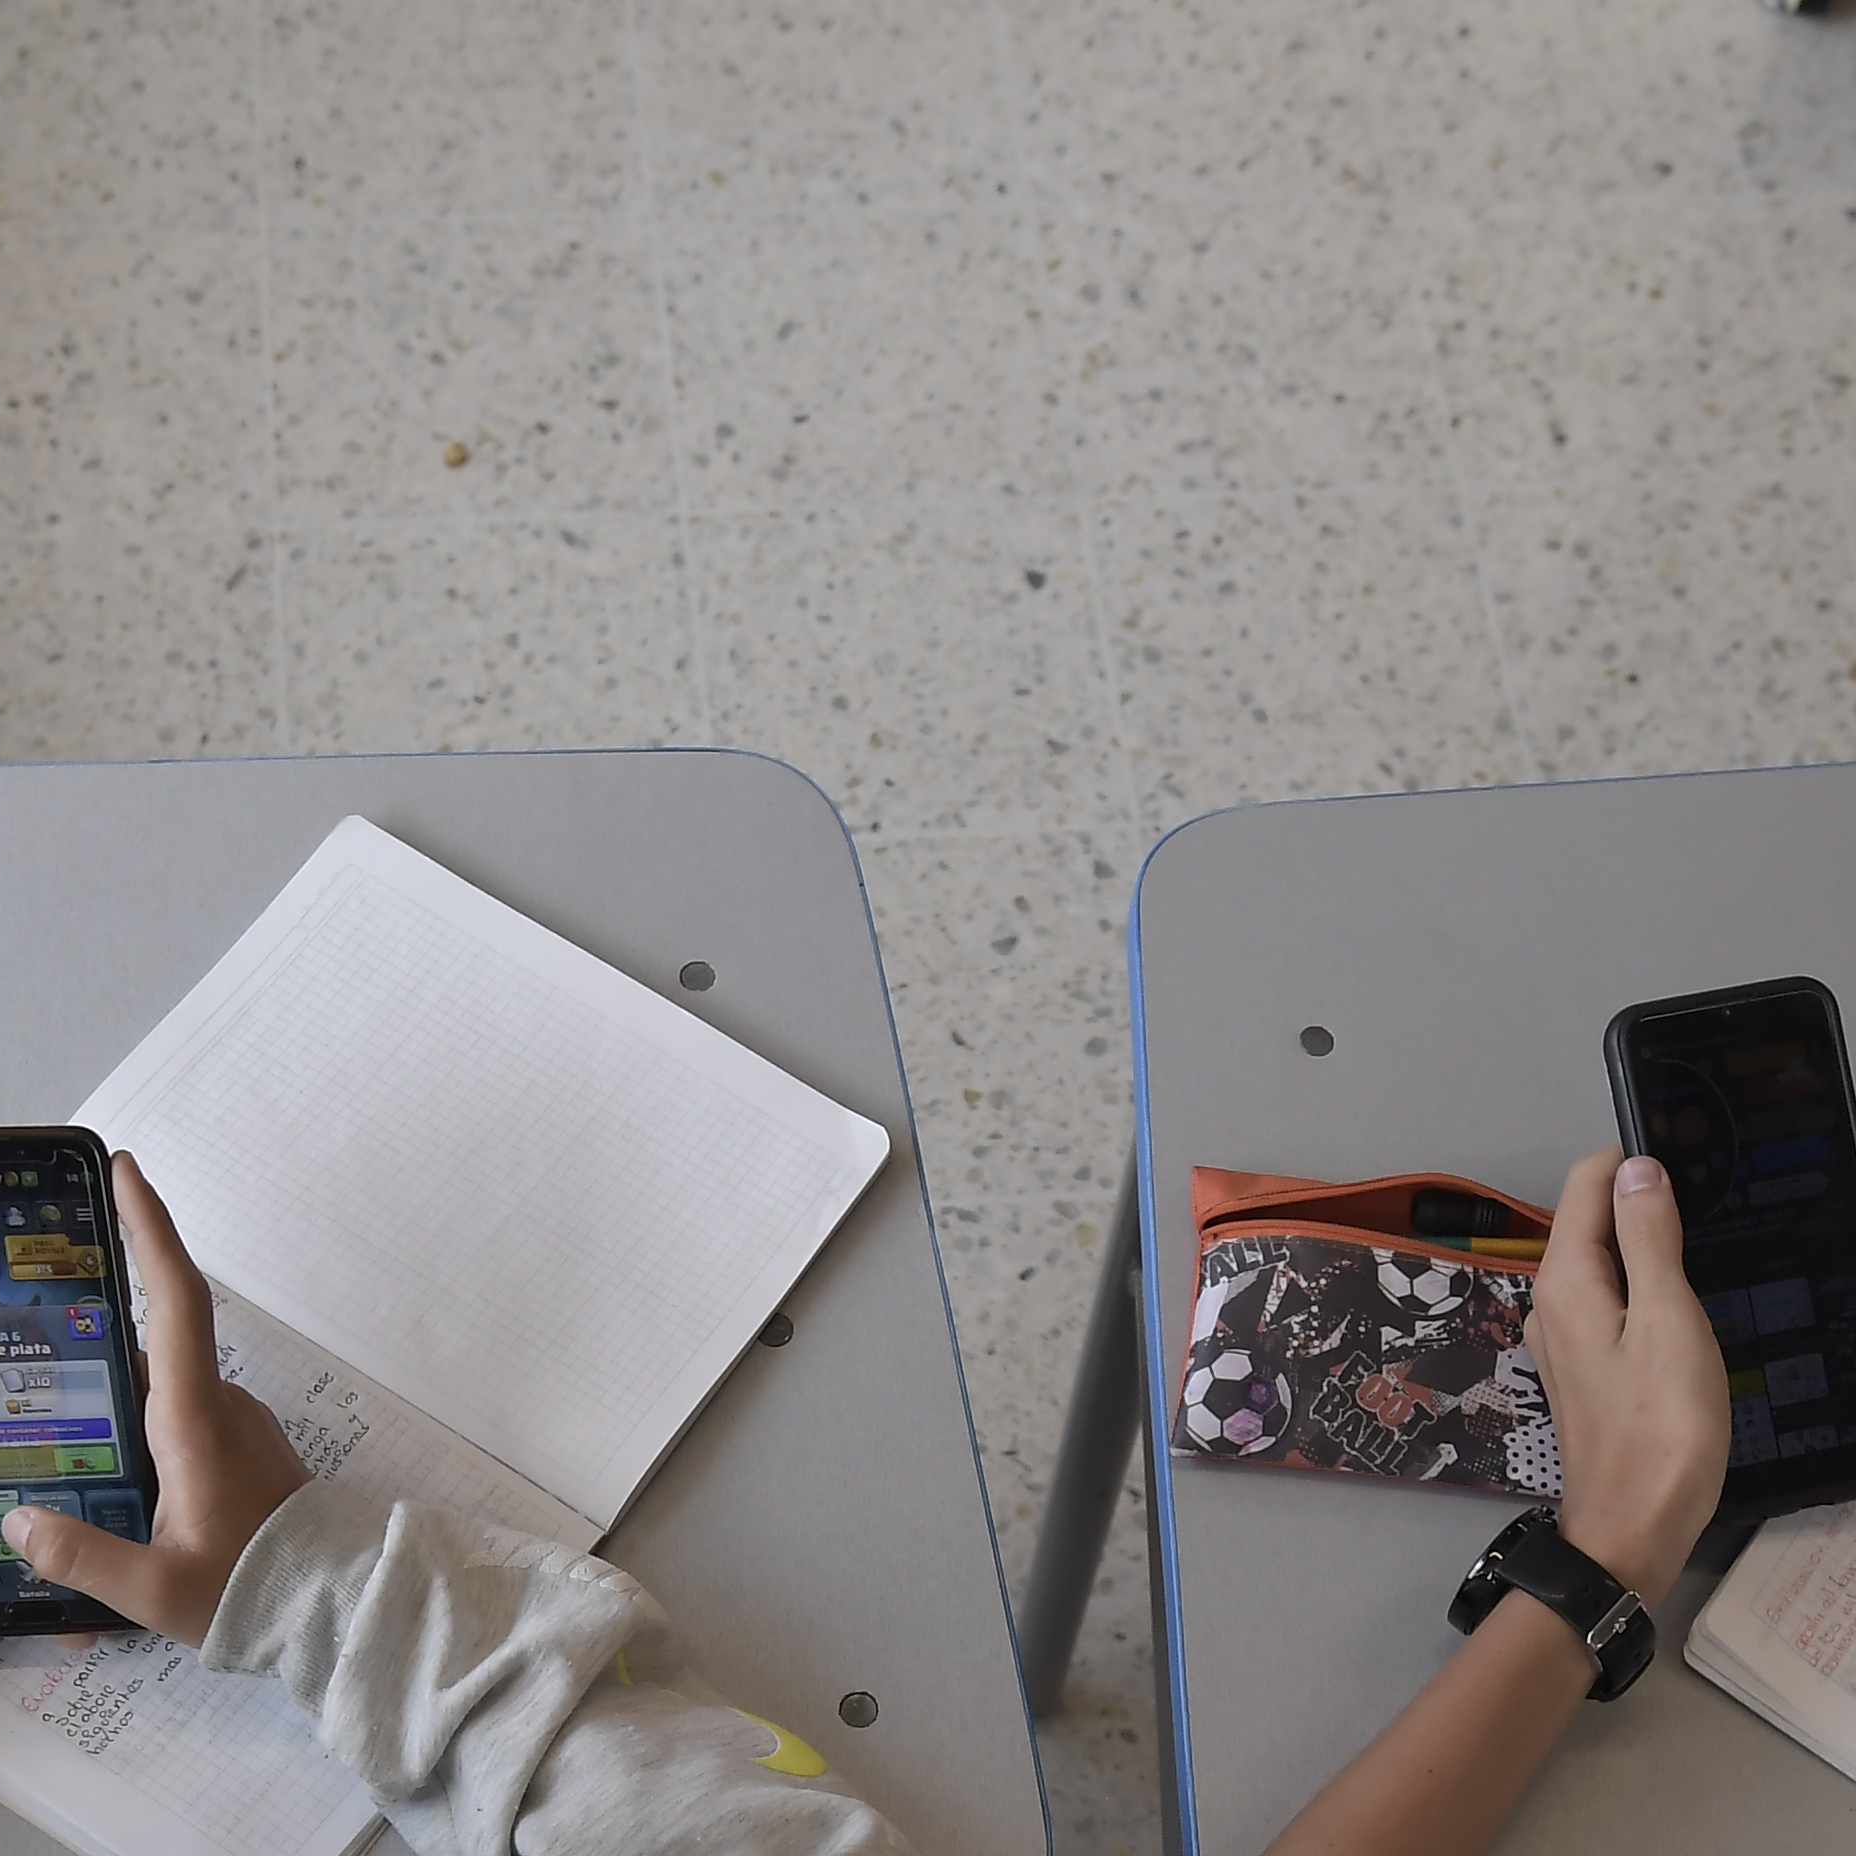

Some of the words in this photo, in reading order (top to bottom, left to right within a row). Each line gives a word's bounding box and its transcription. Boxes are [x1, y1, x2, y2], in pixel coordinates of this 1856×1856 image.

[1206, 1235, 1291, 1288] ALL
[10, 1343, 52, 1358] plata
[1309, 1376, 1408, 1477] BALL
[1336, 1350, 1437, 1440] FOOT
